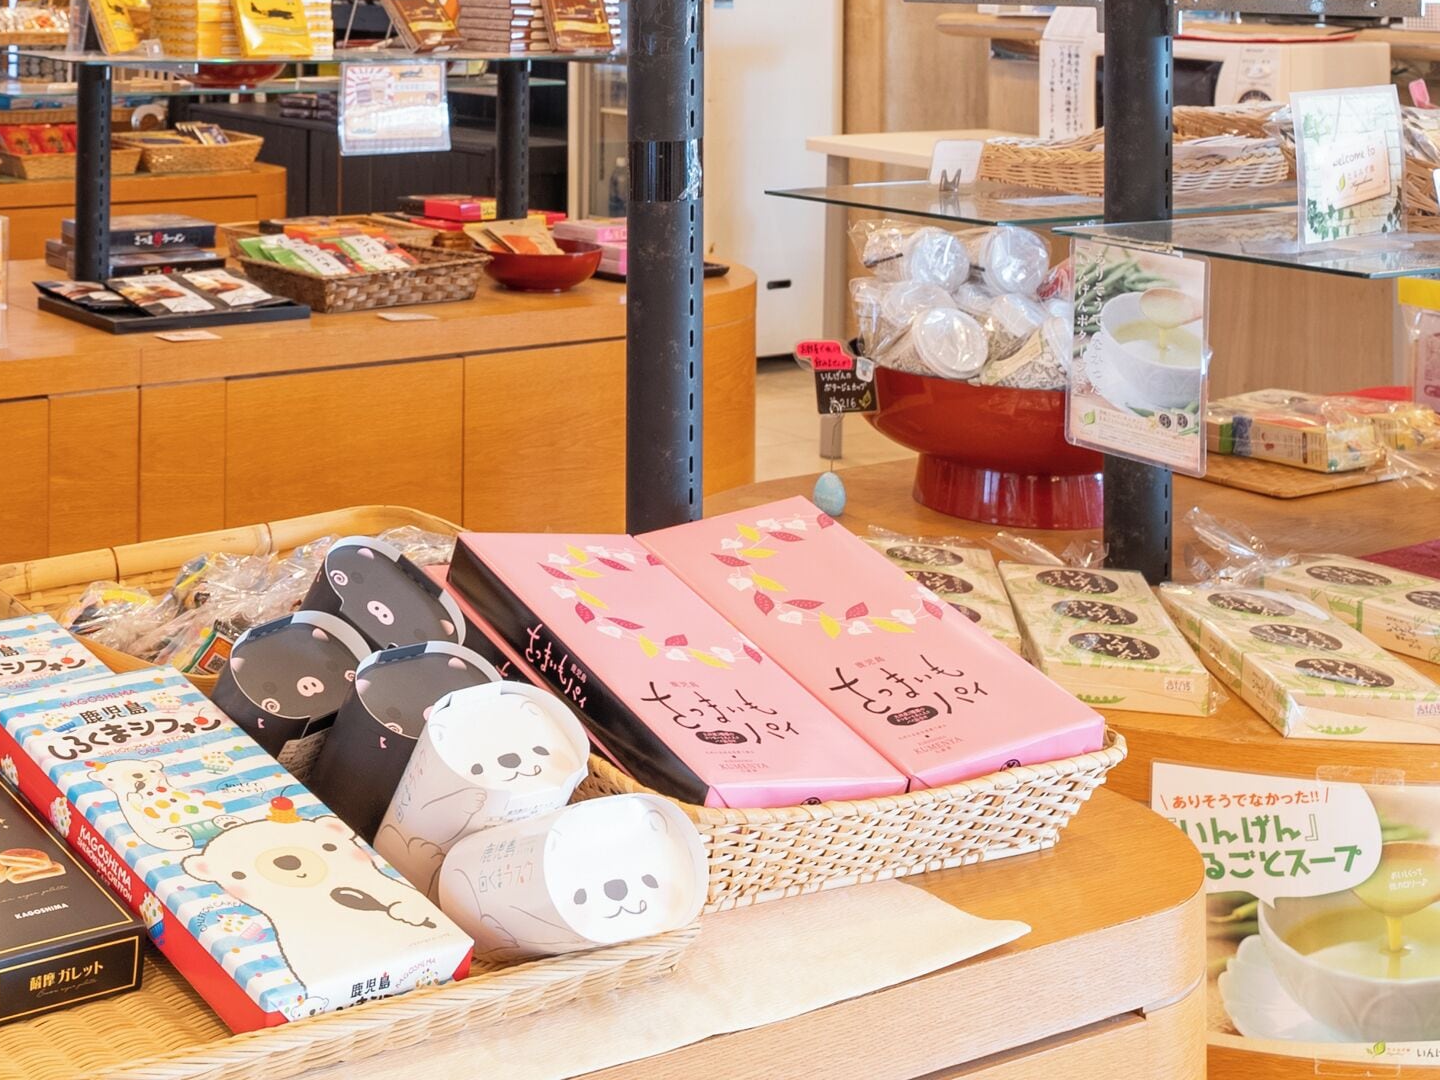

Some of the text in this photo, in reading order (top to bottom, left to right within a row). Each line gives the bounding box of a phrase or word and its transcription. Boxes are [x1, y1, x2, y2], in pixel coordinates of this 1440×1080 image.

[829, 654, 965, 715] さつまいも
[59, 688, 138, 708] KAGOSHIMA
[640, 681, 778, 730] さつまいも
[79, 700, 148, 725] 鹿児島
[48, 718, 222, 760] しろくまシフォン
[1172, 790, 1320, 810] ありそうでなかった!!
[79, 824, 132, 891] KAGOSHIMA
[14, 902, 69, 919] KAGOSHIMA
[350, 973, 391, 999] 鹿児島
